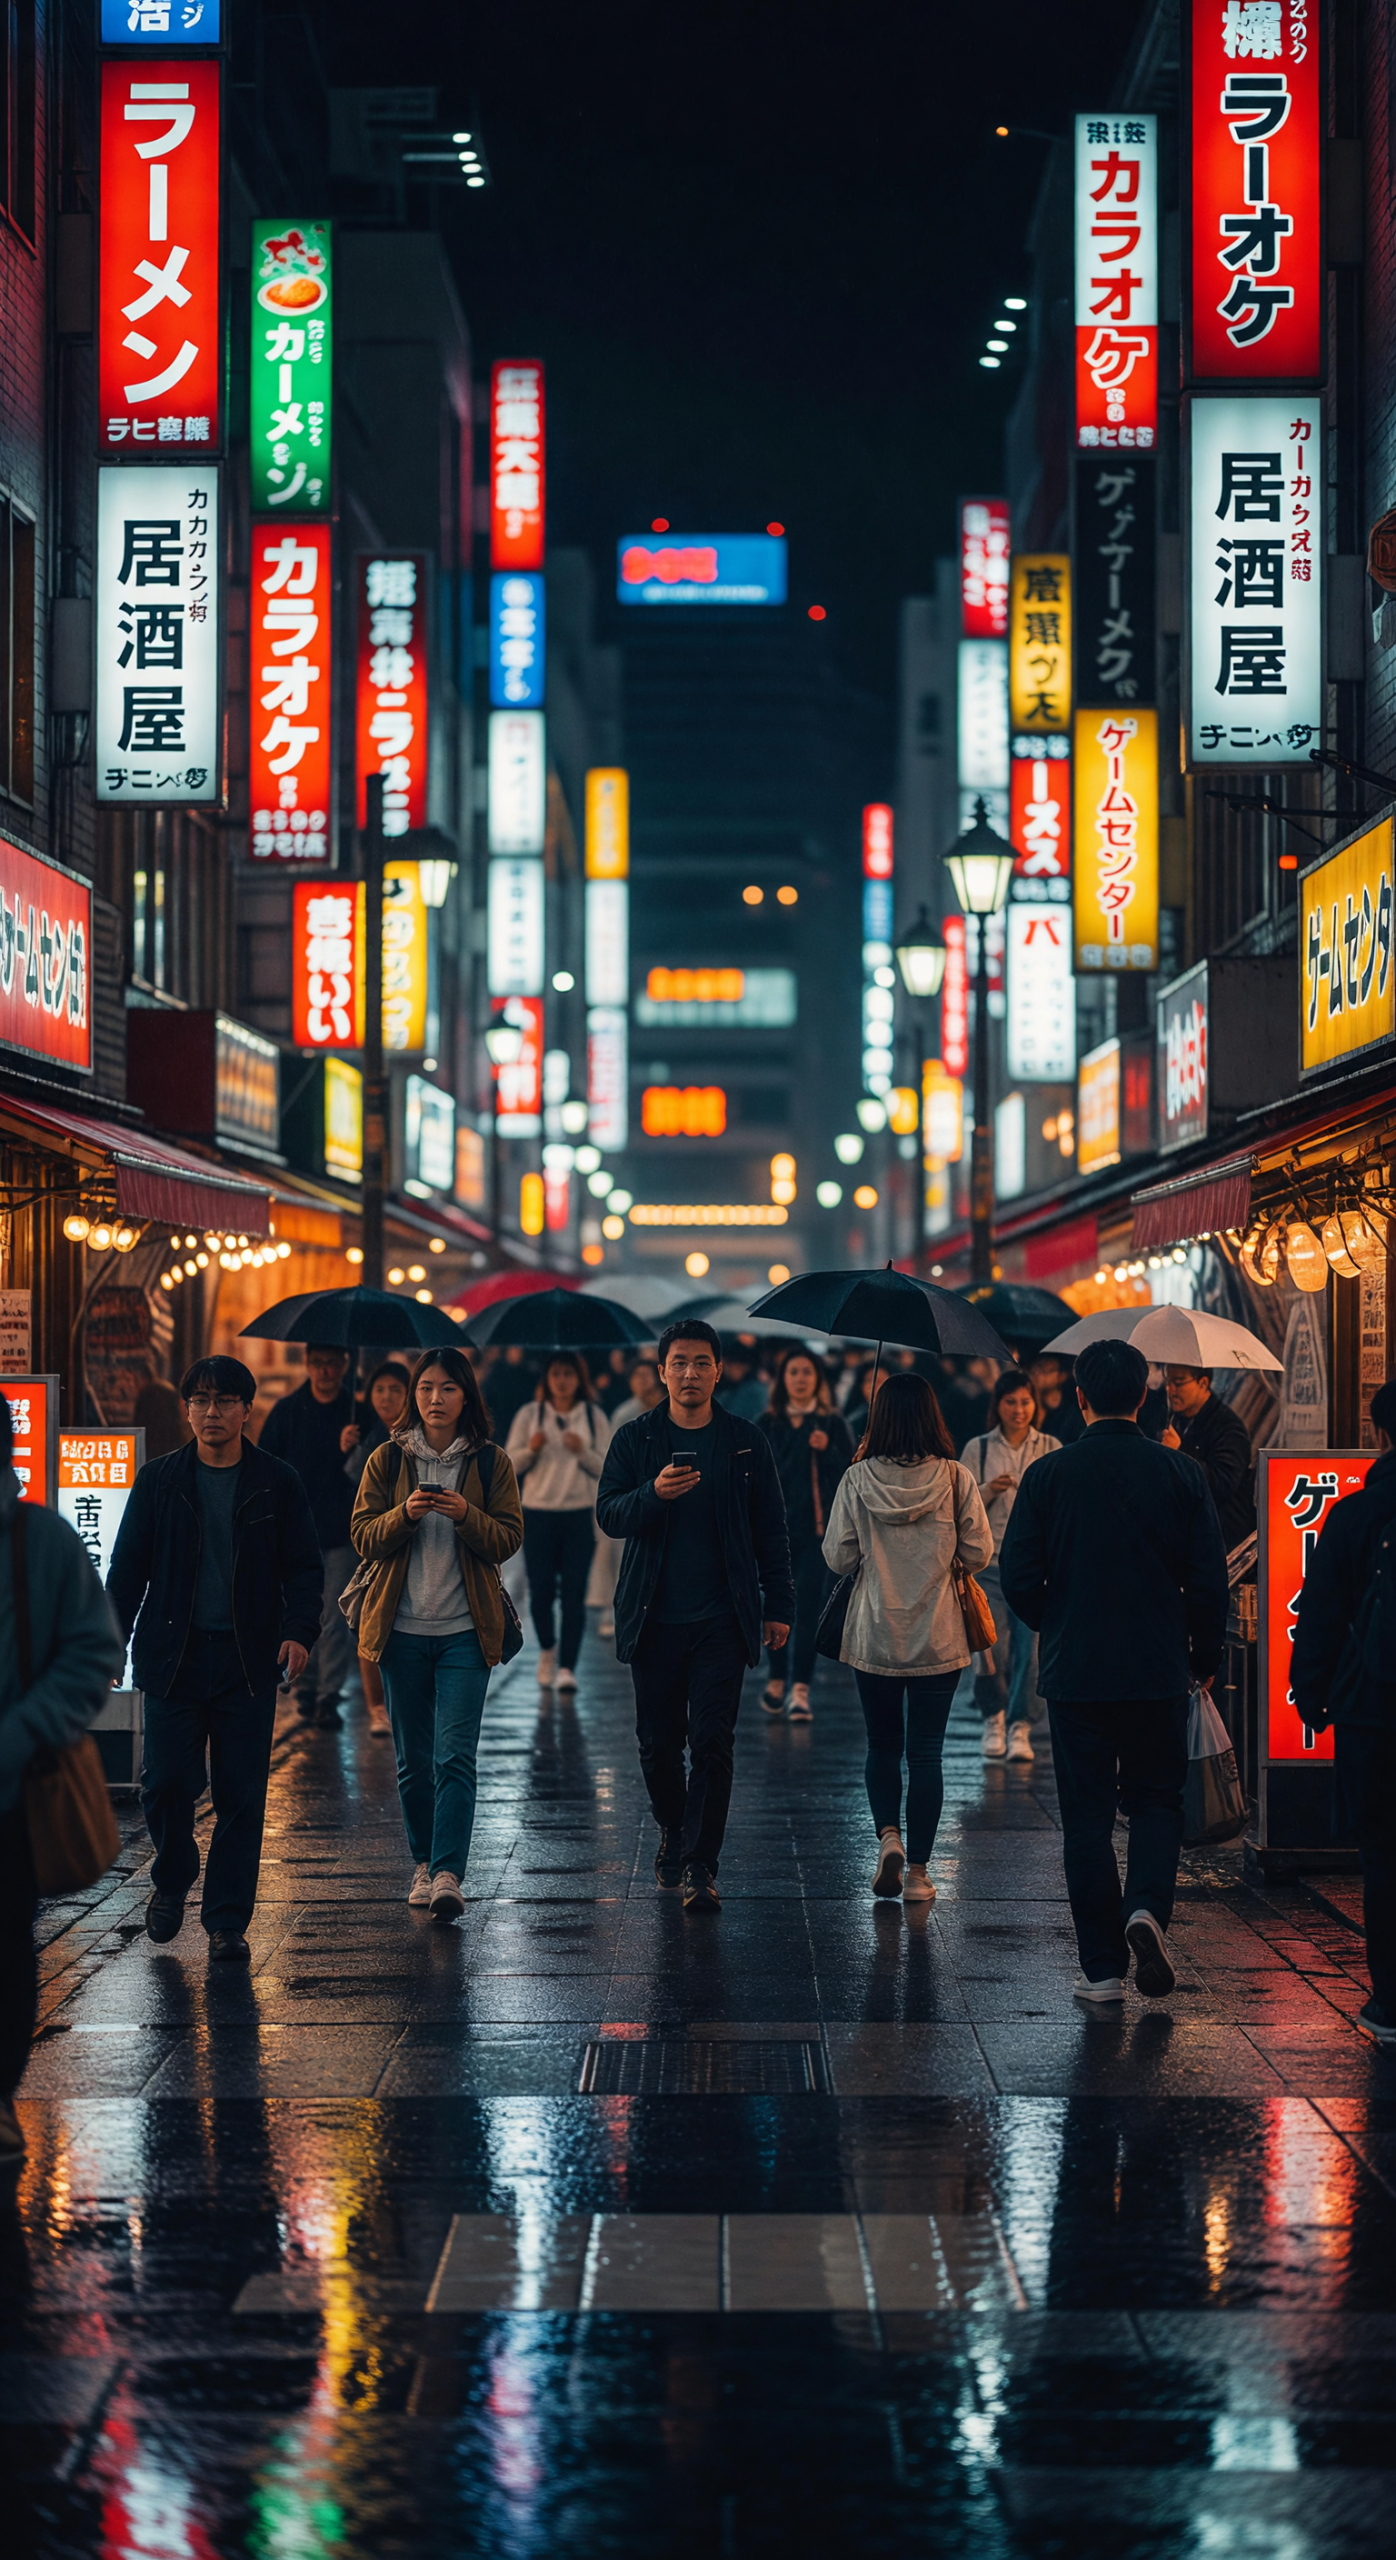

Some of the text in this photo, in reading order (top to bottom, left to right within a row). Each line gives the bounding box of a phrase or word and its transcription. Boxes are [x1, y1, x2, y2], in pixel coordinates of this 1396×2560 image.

[121, 83, 199, 404] ラーメン
[1083, 151, 1149, 389] カラオケ
[1216, 73, 1294, 348] ラーオケ
[117, 520, 186, 752] 居酒屋
[258, 537, 321, 775] カラオケ
[1214, 452, 1288, 696] 居酒屋
[1095, 718, 1138, 945] ゲームセンター
